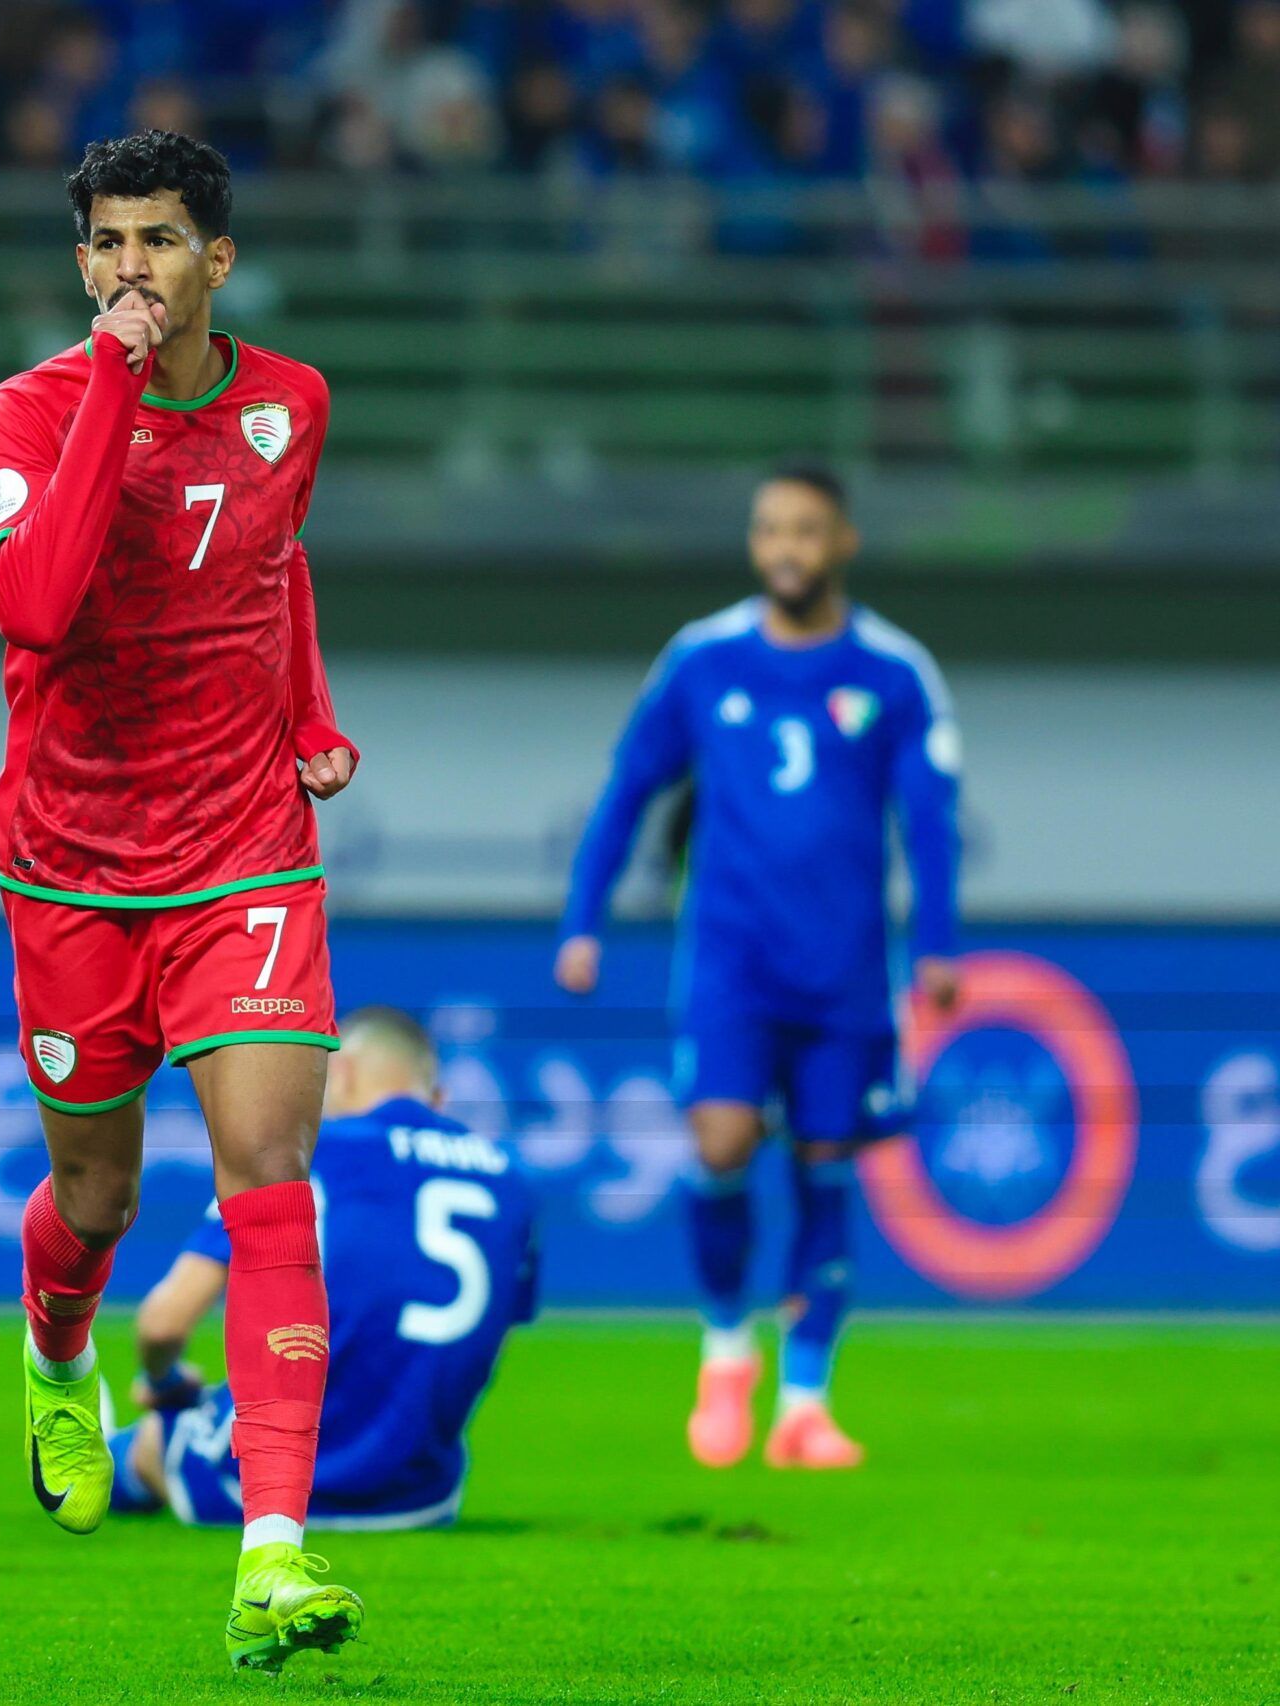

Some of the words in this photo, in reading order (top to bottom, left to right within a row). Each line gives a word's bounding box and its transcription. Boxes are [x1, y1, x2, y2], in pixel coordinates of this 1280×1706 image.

[185, 484, 224, 570] 7
[774, 718, 813, 792] 3
[248, 906, 287, 990] 7
[232, 997, 305, 1015] Kappa
[397, 1177, 497, 1344] 5
